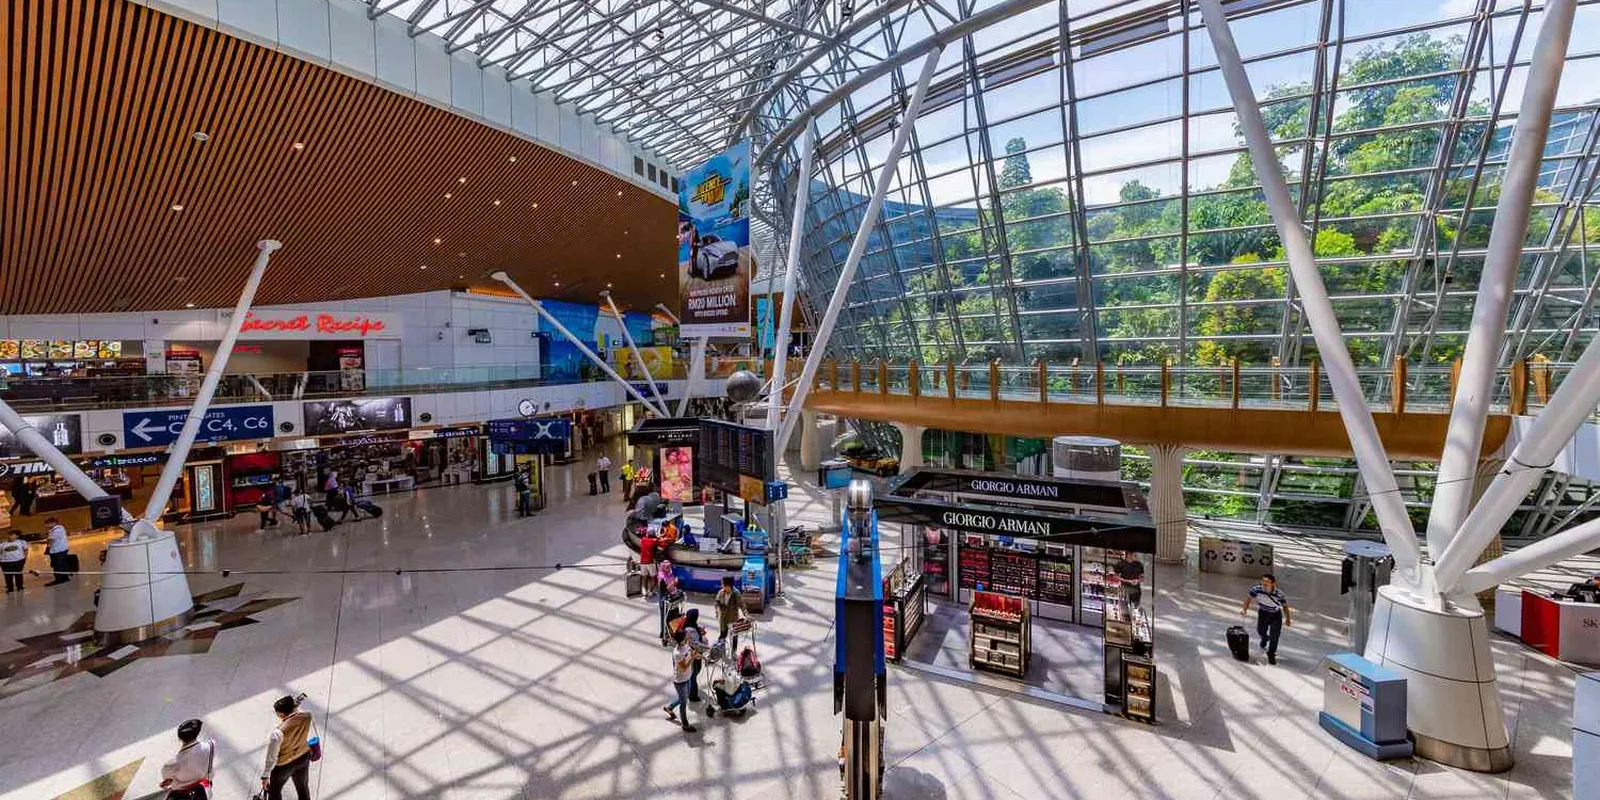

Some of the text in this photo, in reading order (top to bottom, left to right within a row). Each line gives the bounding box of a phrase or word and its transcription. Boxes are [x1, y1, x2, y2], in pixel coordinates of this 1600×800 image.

[688, 293, 736, 310] RM20 MILLION
[238, 311, 385, 336] Secret Recipe
[207, 417, 238, 432] C4,
[243, 416, 268, 429] C6
[971, 479, 1058, 497] GIORGIO ARMANI
[943, 511, 1050, 536] GIORGIO ARMANI
